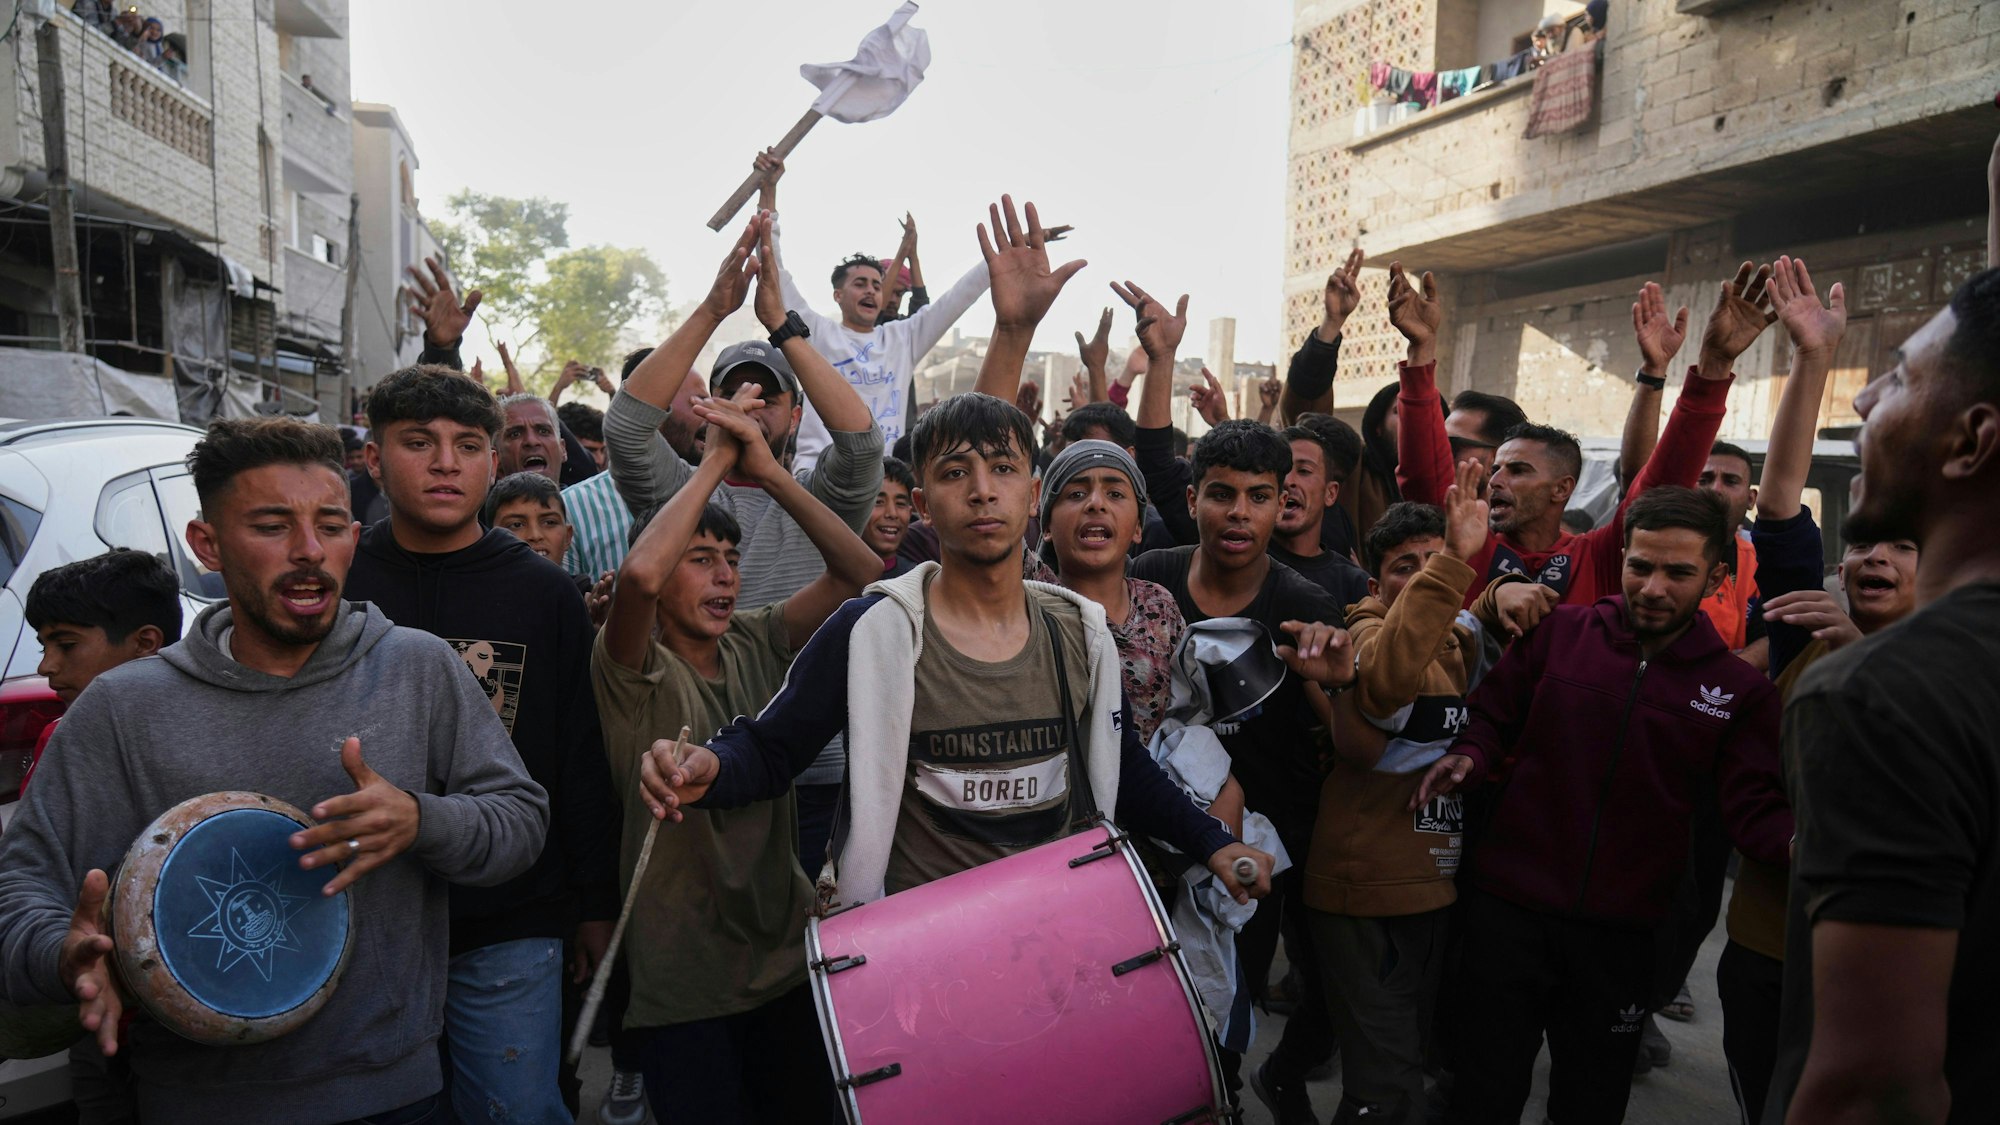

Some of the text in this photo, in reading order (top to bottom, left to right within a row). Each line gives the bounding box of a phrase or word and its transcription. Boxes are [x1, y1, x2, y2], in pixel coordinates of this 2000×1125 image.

[1690, 700, 1731, 720] adidas
[929, 725, 1064, 757] CONSTANTLY
[963, 776, 1038, 802] BORED
